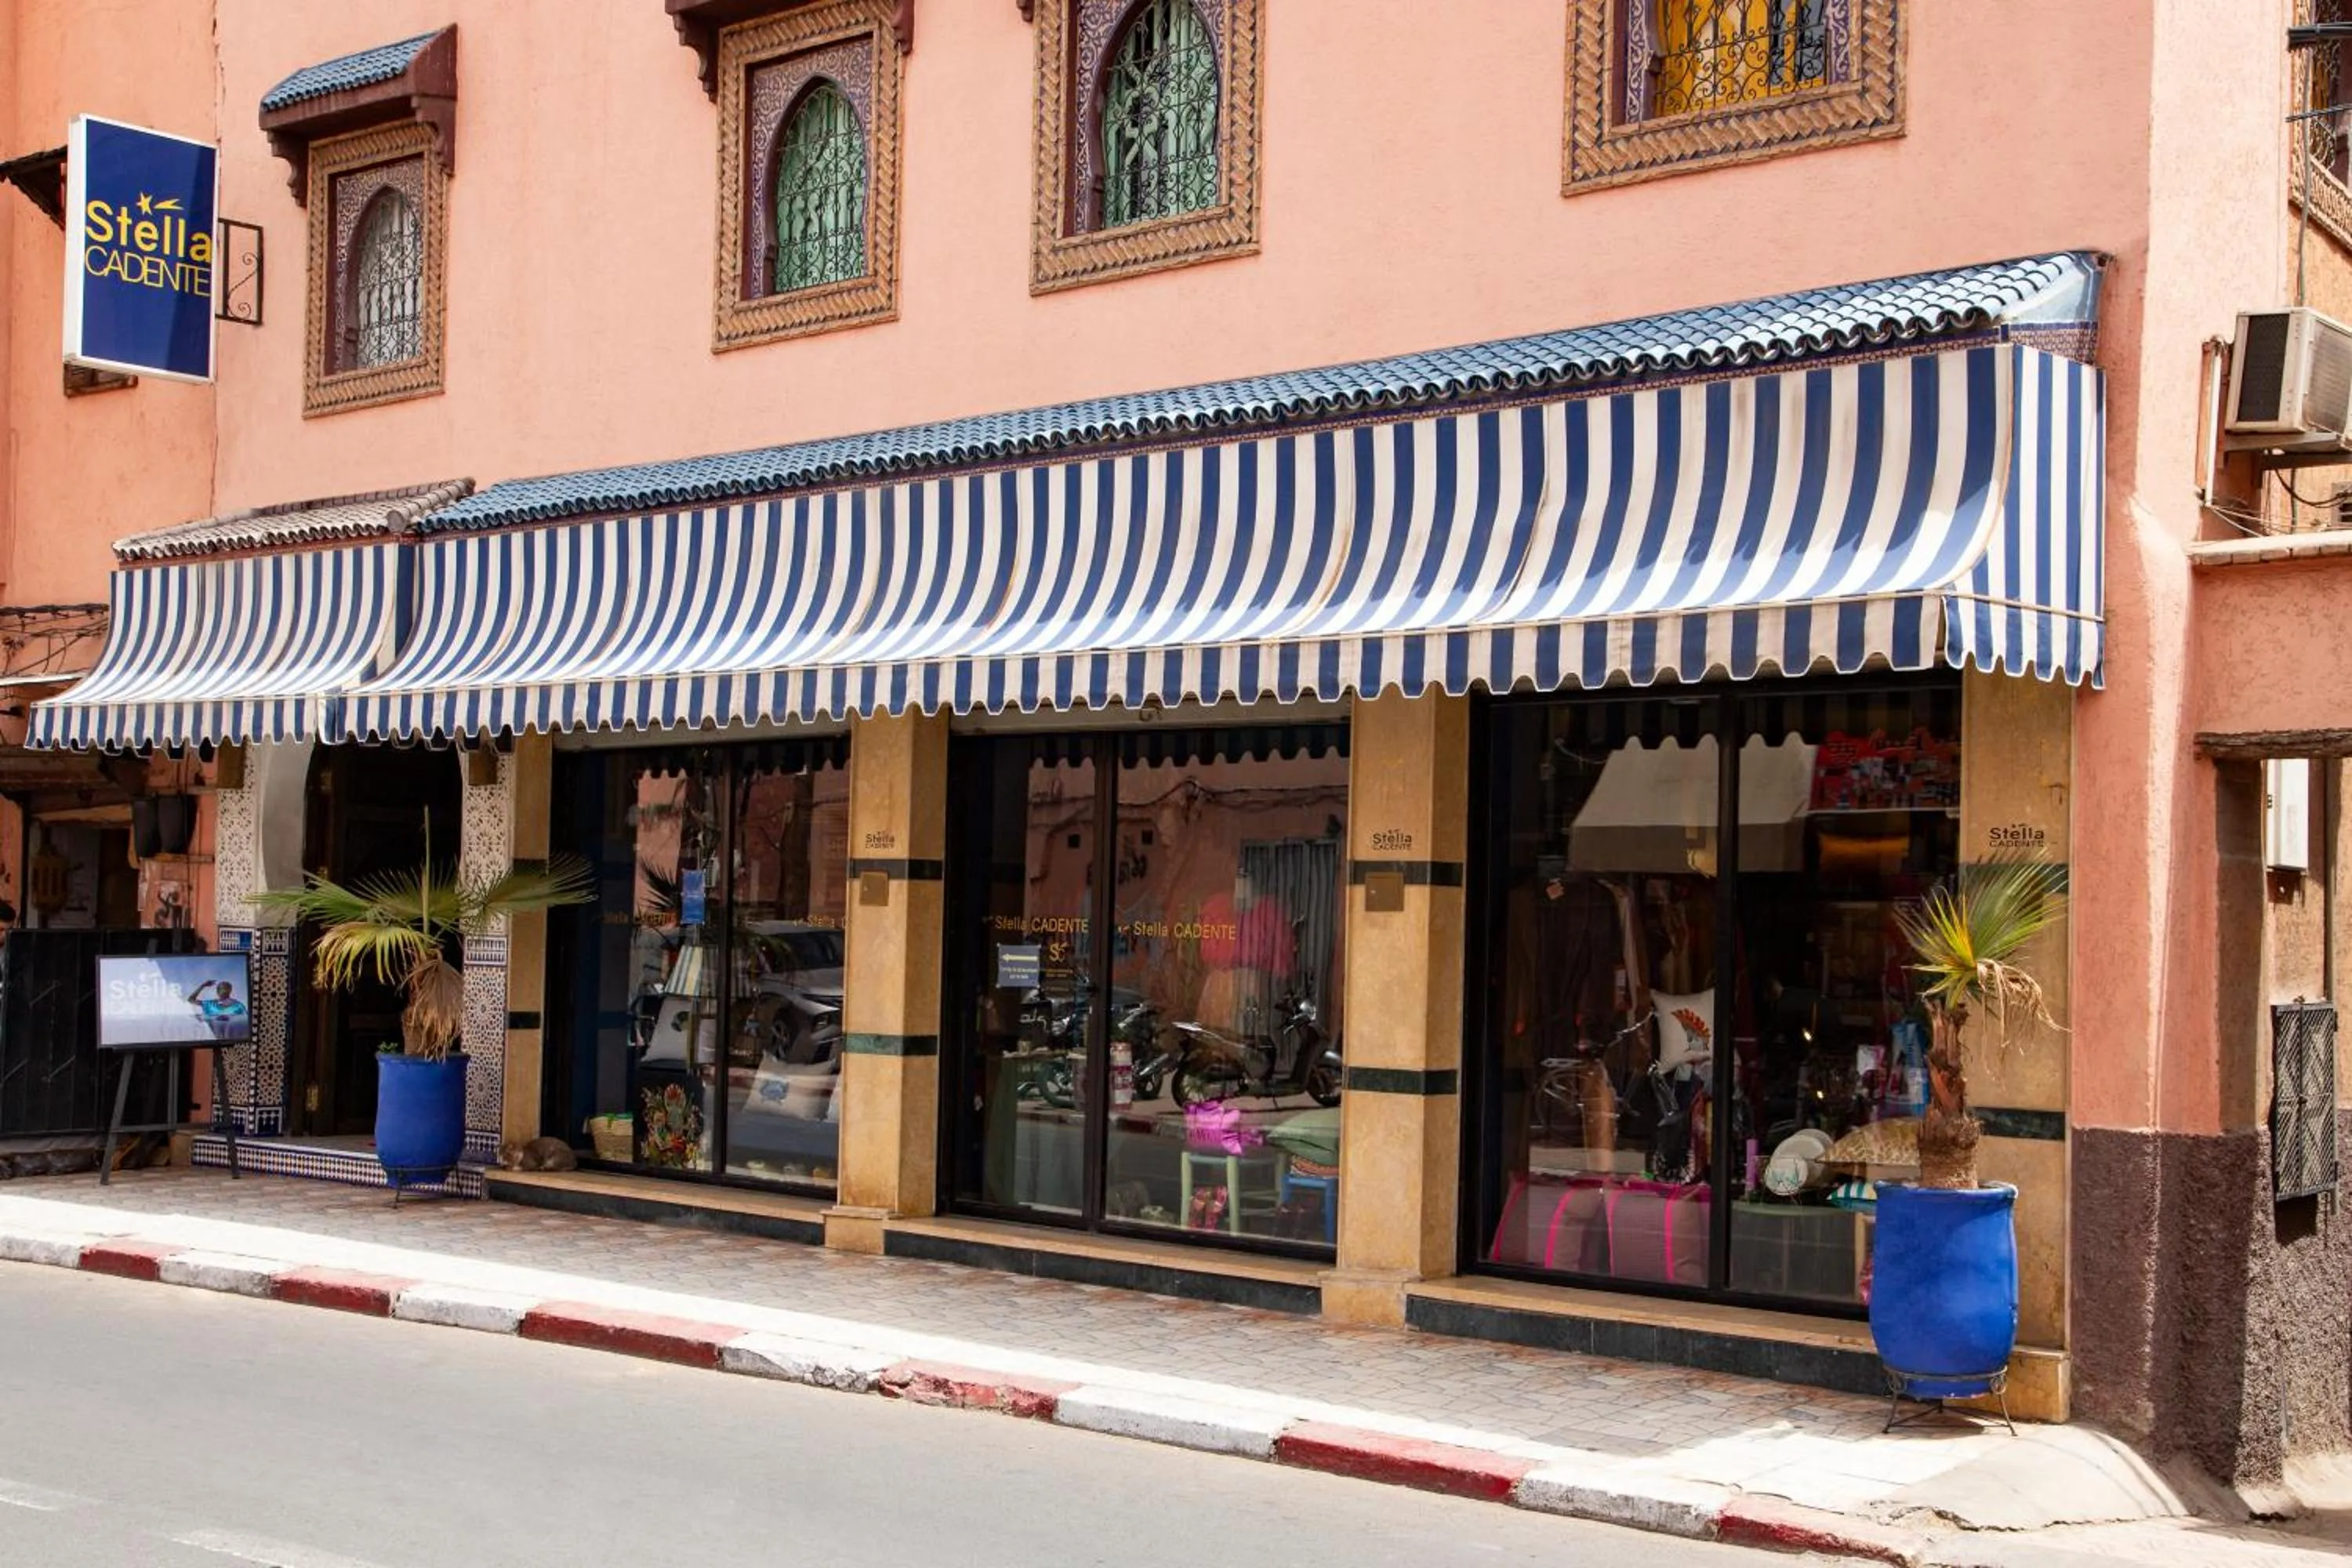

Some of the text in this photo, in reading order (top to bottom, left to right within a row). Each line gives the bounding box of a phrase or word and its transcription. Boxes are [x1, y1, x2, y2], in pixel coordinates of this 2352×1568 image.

[85, 200, 211, 263] Stella
[85, 245, 211, 297] CADENTE
[1373, 833, 1411, 844] Stella
[1989, 827, 2044, 840] Stella
[995, 916, 1089, 933] Stella CADENTE
[1134, 921, 1236, 940] Stella CADENTE
[110, 978, 183, 999] Stella
